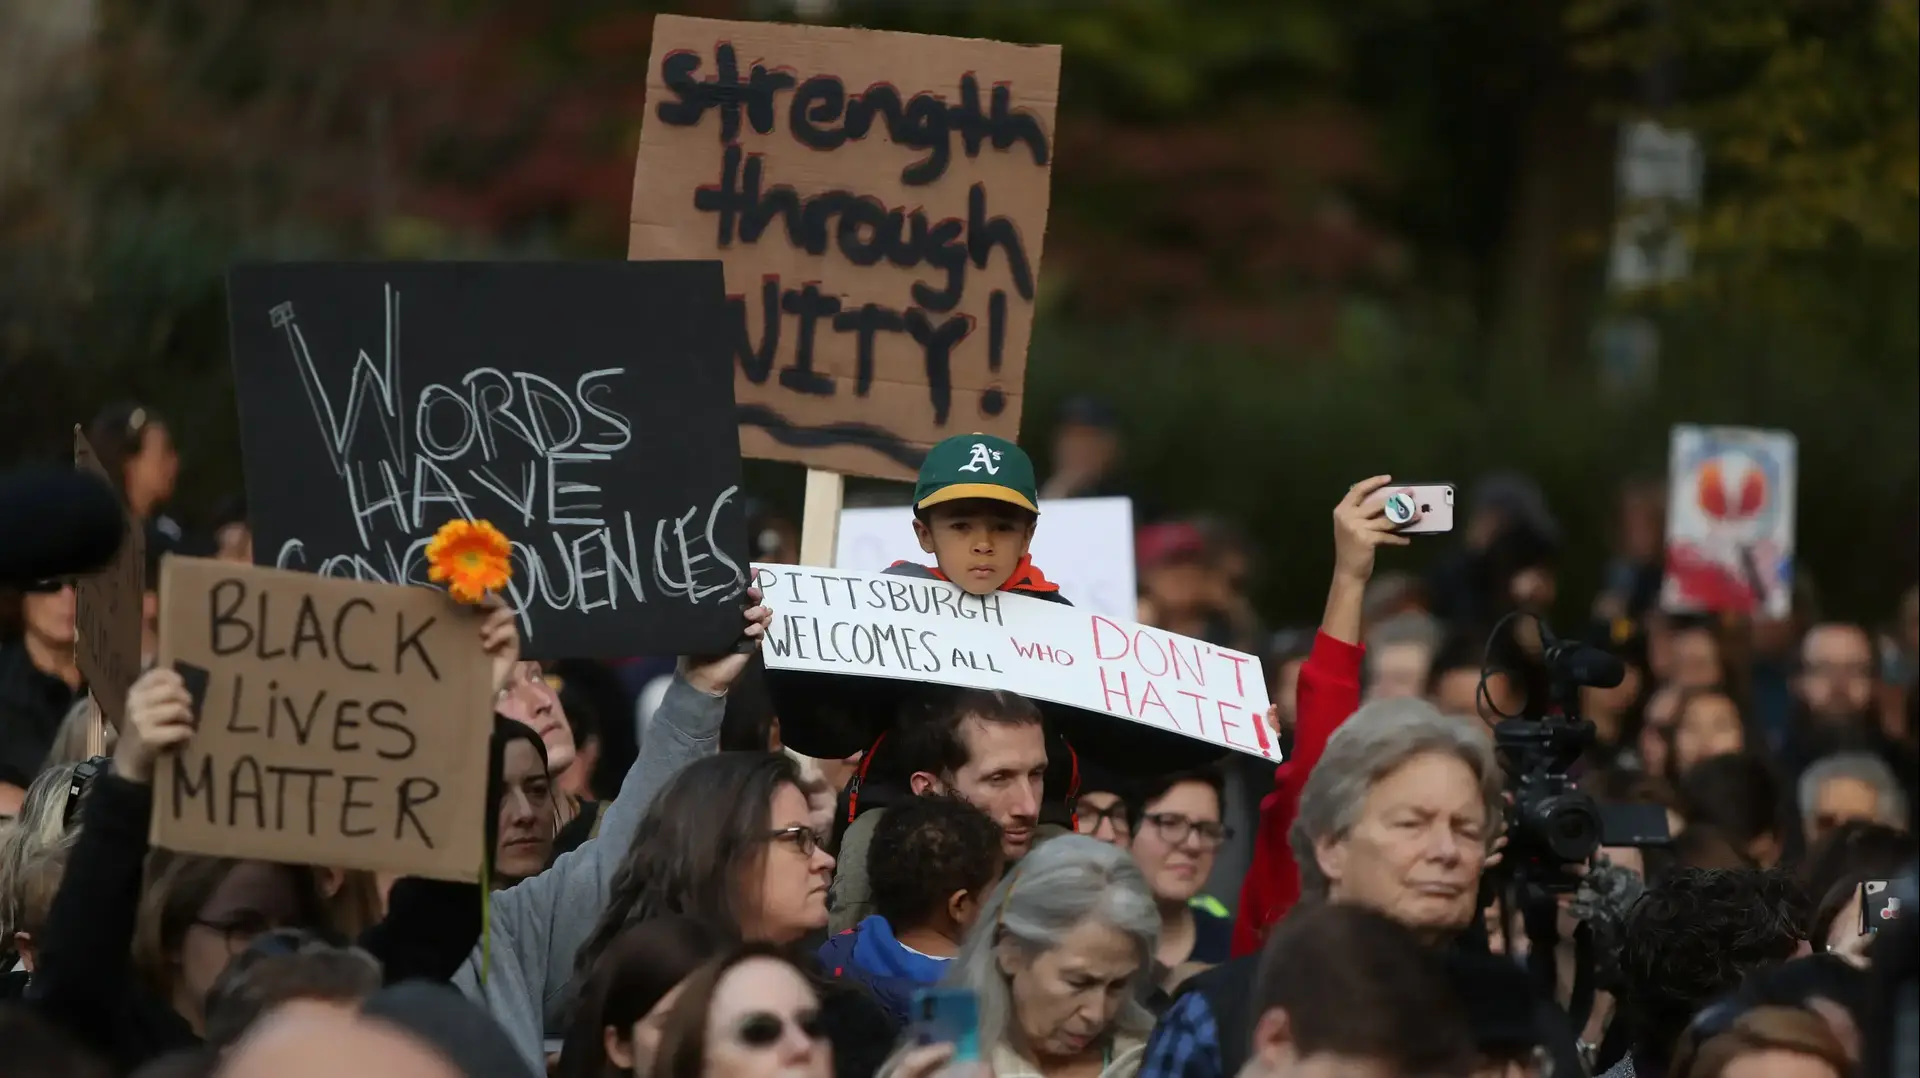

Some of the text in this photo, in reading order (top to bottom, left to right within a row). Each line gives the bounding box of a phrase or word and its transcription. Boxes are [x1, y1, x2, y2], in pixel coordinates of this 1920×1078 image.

[657, 39, 1046, 185] strength
[694, 144, 1033, 311] through
[269, 283, 631, 475] WORDS
[726, 275, 1006, 427] NITY!
[345, 451, 605, 550] HAVE
[210, 578, 440, 681] BLACK
[757, 568, 1003, 626] PITTSBURGH
[765, 614, 1075, 674] WELCOMES ALL WHO
[1091, 615, 1250, 698] DON'T
[1099, 667, 1272, 758] HATE!
[172, 753, 440, 849] MATTER
